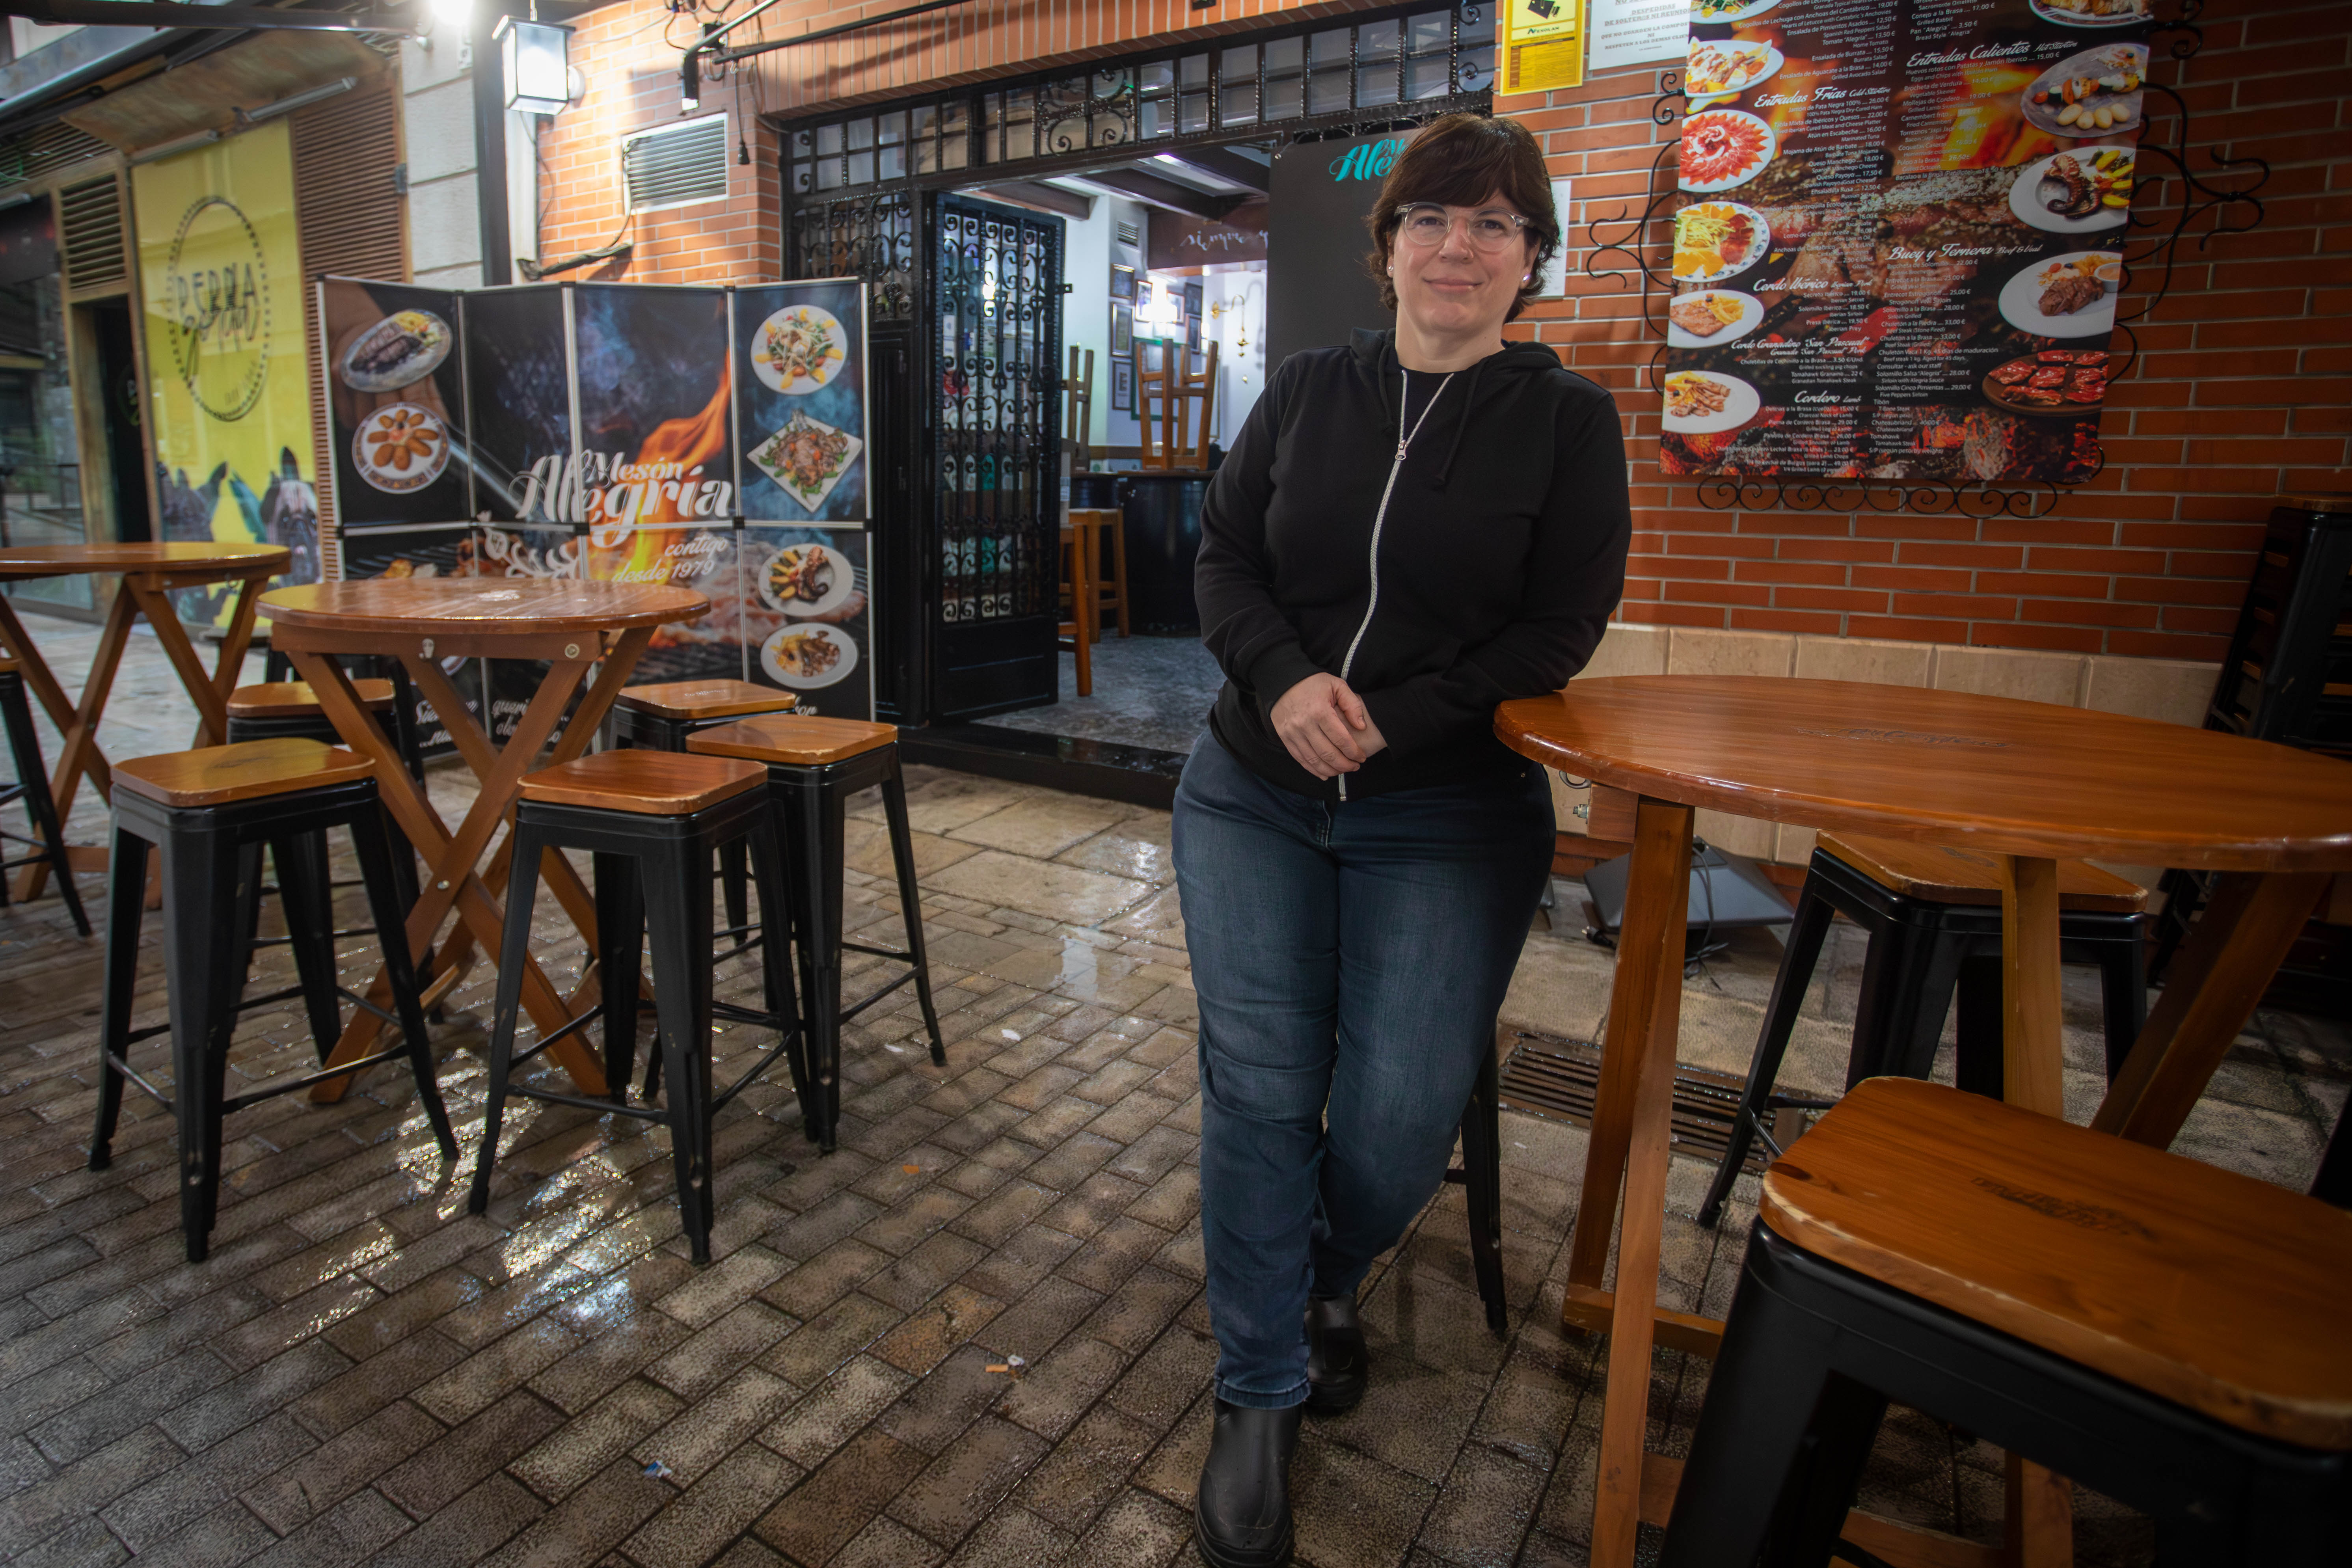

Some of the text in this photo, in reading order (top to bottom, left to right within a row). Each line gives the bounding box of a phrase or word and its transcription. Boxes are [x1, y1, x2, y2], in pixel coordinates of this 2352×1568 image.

[1918, 2, 1951, 11] Sacromonte
[1615, 15, 1650, 25] SOLTERS
[1906, 48, 1968, 67] Entradas
[1970, 41, 2031, 60] Calientes
[1812, 69, 1838, 77] Aguacate
[1754, 90, 1808, 108] Entradas
[1810, 86, 1847, 101] Frías
[1885, 246, 1926, 262] Buey
[1926, 250, 1937, 262] y
[1939, 243, 1994, 257] Ternera
[1753, 277, 1787, 291] Cerdo
[1794, 390, 1840, 403] Cordero
[580, 448, 683, 489] Mesón
[508, 453, 735, 548] Alegría
[664, 535, 729, 560] contigo
[611, 559, 715, 583] desde 1979
